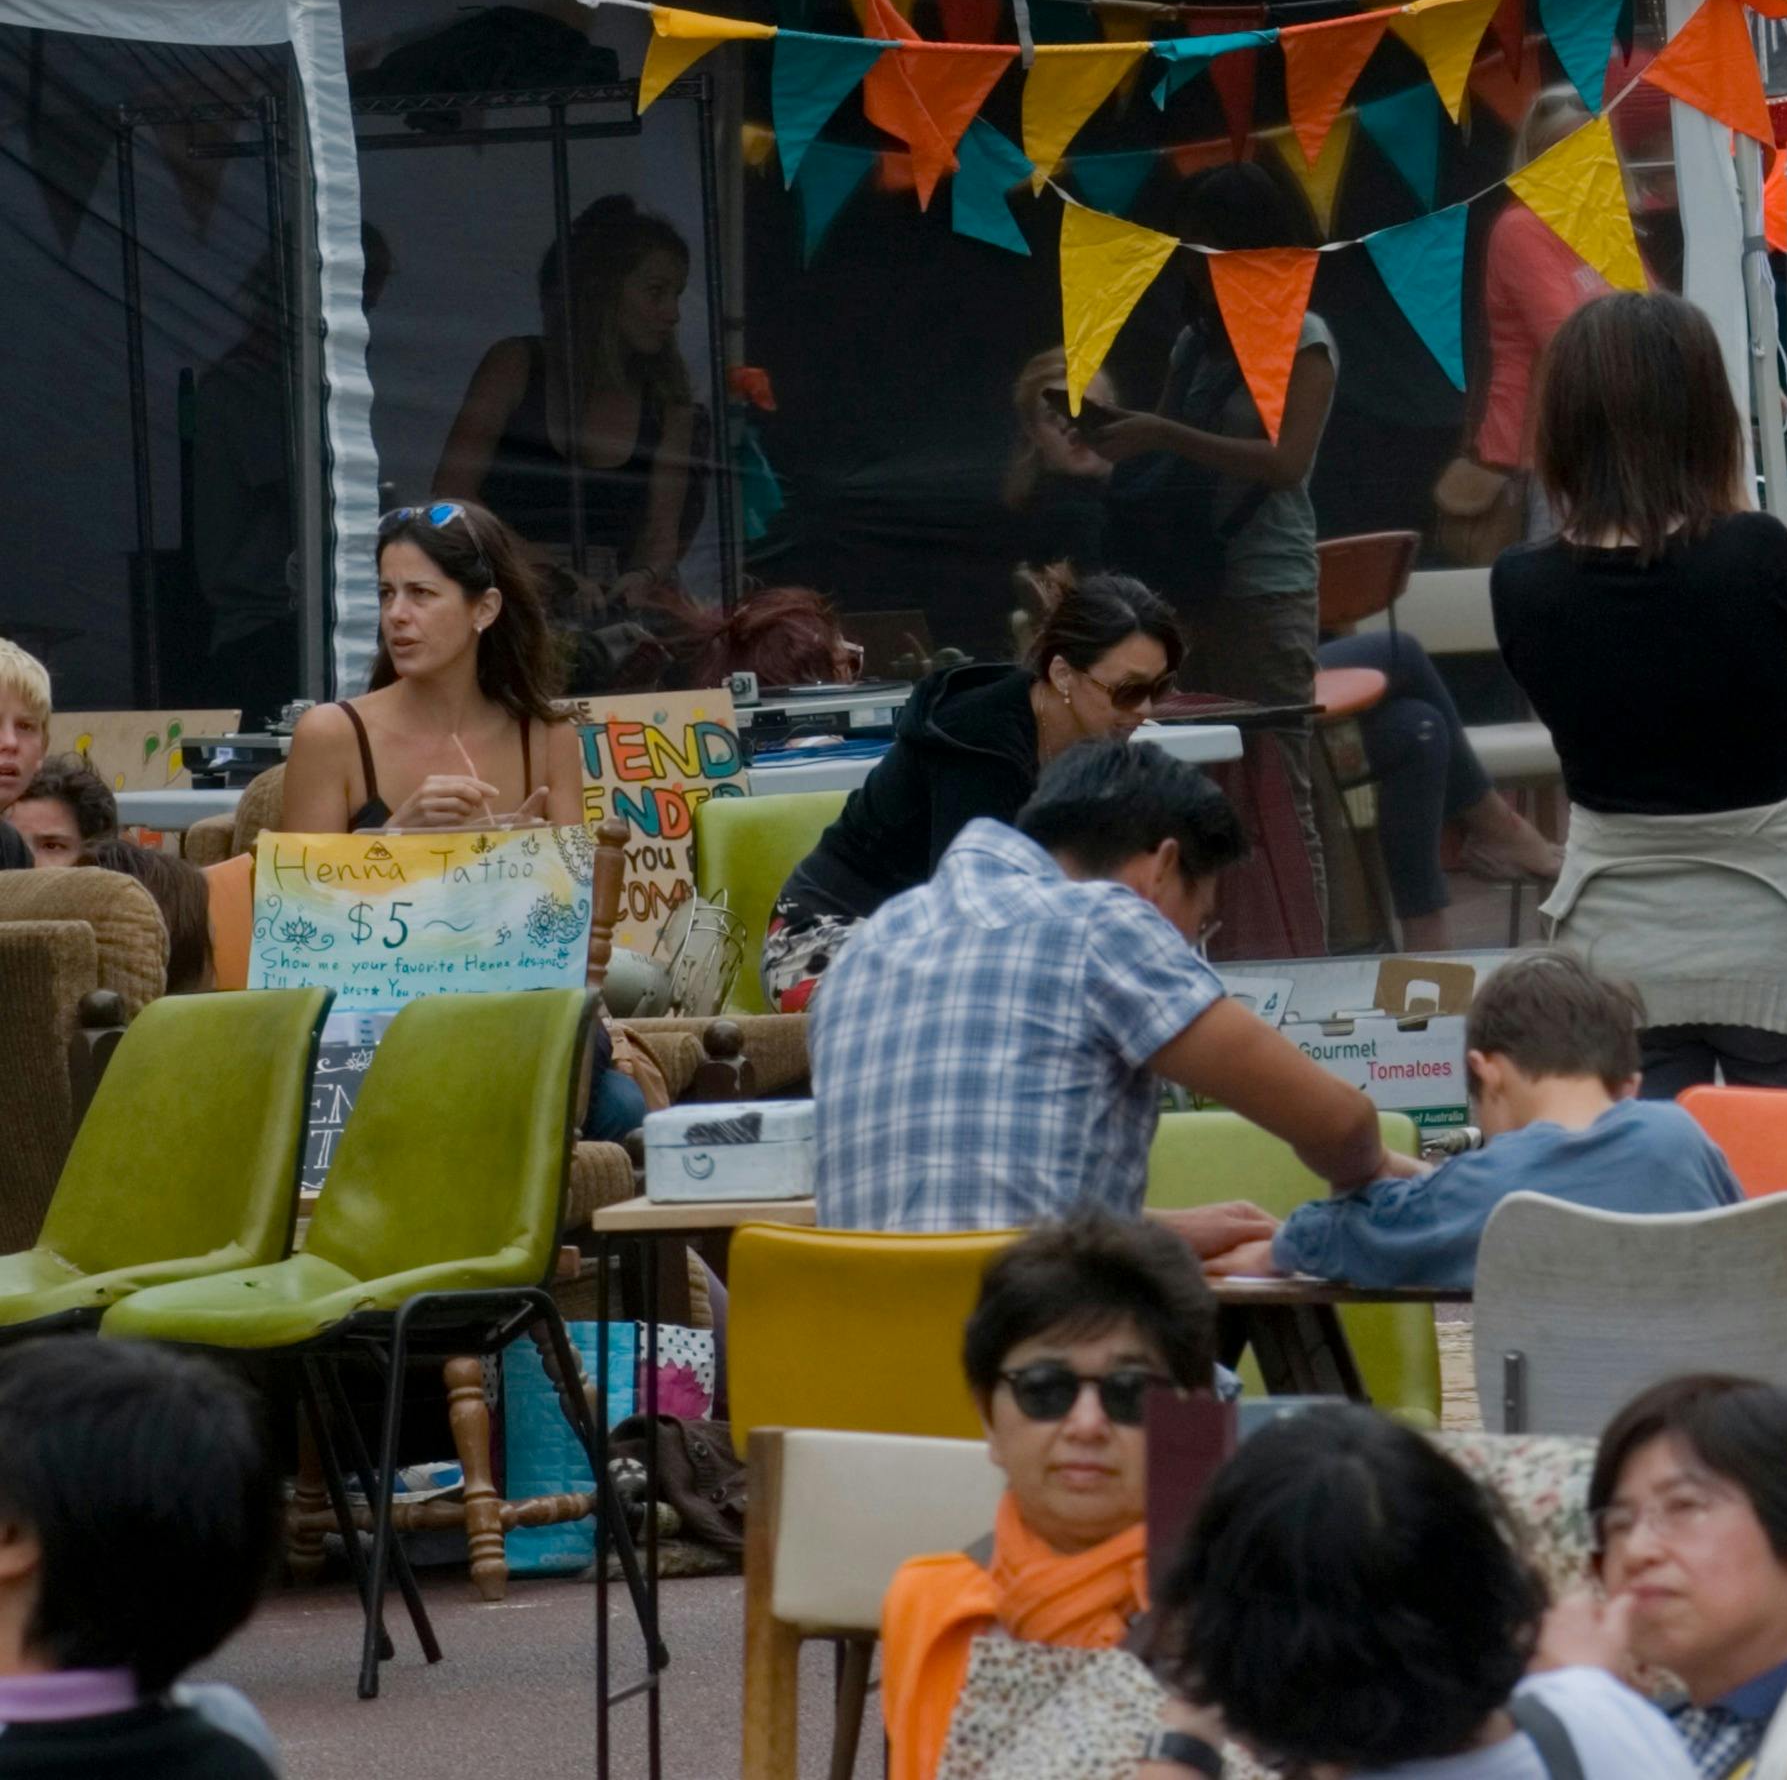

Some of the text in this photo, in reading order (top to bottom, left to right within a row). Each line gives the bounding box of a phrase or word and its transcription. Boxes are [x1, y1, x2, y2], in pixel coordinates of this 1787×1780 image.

[575, 721, 743, 782] TEND
[273, 843, 535, 891] Henna Tattoo
[624, 845, 676, 872] YOU
[347, 901, 413, 949] $5
[260, 947, 311, 970] Show
[318, 961, 340, 971] me
[351, 959, 388, 977] your
[1300, 1039, 1377, 1061] Gourmet
[1366, 1060, 1452, 1081] Tomatoes
[1424, 1111, 1465, 1123] Australia
